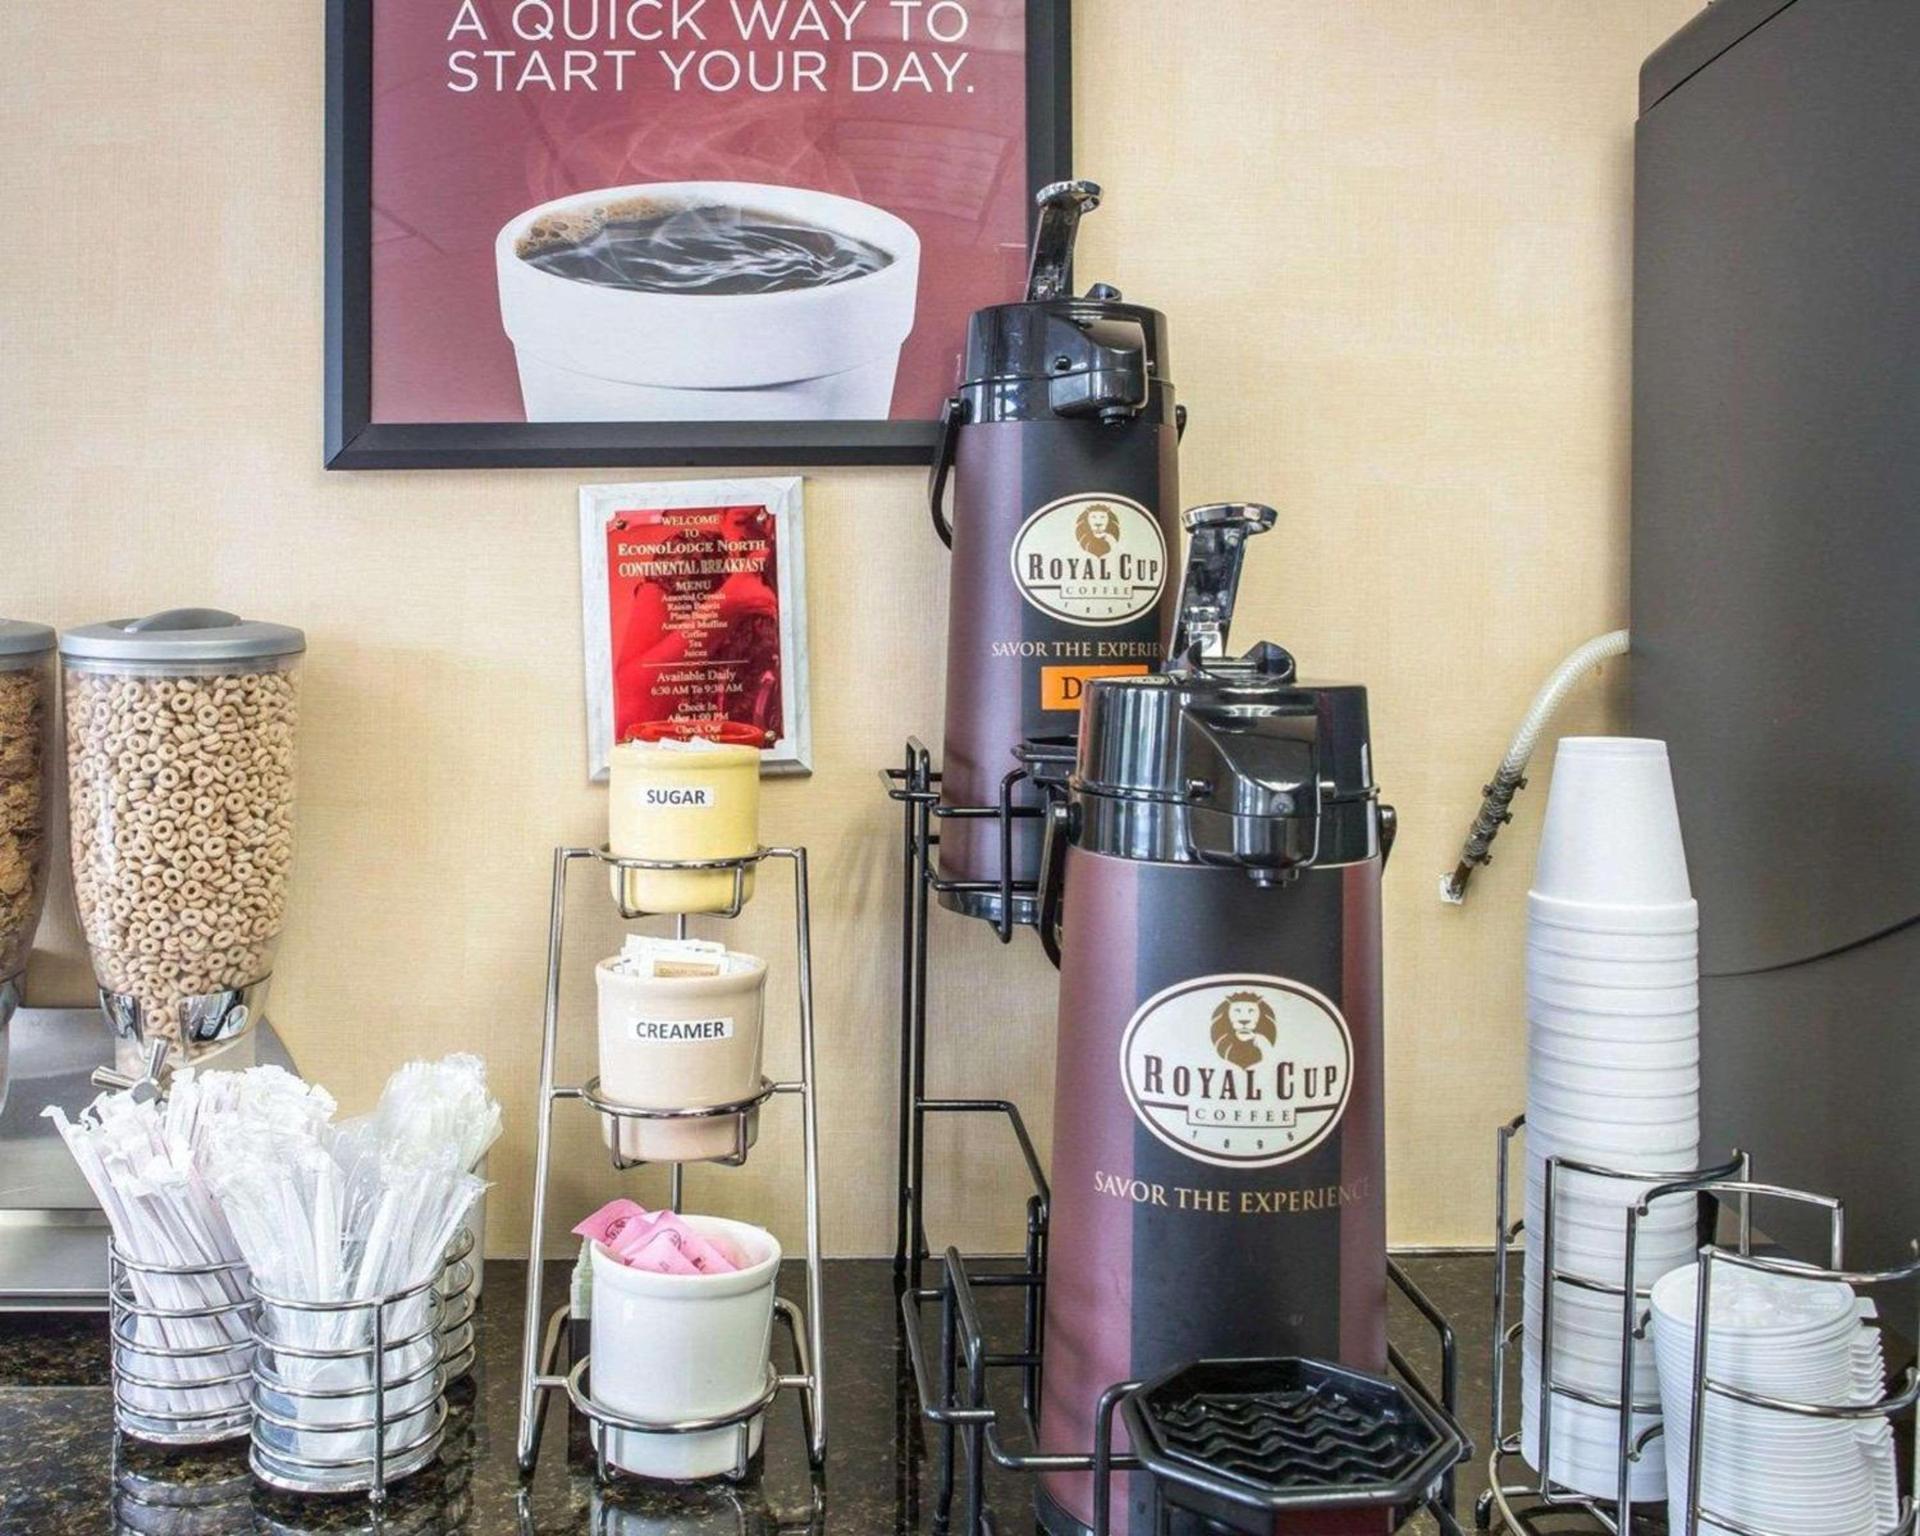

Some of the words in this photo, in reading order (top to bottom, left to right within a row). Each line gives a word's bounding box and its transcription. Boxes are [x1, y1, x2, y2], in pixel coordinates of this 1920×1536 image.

[446, 0, 488, 41] A
[511, 0, 706, 42] QUICK
[731, 0, 868, 41] WAY
[890, 0, 970, 42] TO
[447, 50, 636, 93] START
[659, 50, 828, 93] YOUR
[851, 50, 975, 93] DAY.
[662, 514, 719, 526] WELCOME
[684, 528, 700, 538] TO
[718, 540, 768, 553] NORTH
[619, 560, 700, 577] CONTINENTAL
[701, 557, 766, 575] BREAKFAST
[1028, 553, 1111, 580] ROYAL
[1120, 553, 1158, 581] CUP
[676, 580, 711, 591] MENU
[1066, 586, 1131, 596] COFFEE
[697, 620, 728, 629] Muffins
[681, 630, 708, 638] Coffee
[689, 640, 702, 648] Tea
[992, 641, 1047, 657] SAVOR
[1052, 642, 1092, 657] THE
[684, 649, 708, 657] Juices
[657, 671, 706, 682] Available
[708, 667, 736, 681] Daily
[672, 685, 689, 695] AM
[692, 685, 703, 694] To
[705, 684, 724, 693] 9:30
[725, 683, 743, 693] AM
[678, 703, 706, 713] Check
[667, 713, 691, 723] After
[646, 789, 706, 805] SUGAR
[636, 1021, 725, 1039] CREAMER
[1143, 1054, 1262, 1101] ROYAL
[1277, 1062, 1338, 1100] CUP
[1195, 1109, 1290, 1123] COFFEE
[1094, 1170, 1168, 1207] SAVOR
[1174, 1187, 1230, 1213] THE
[1240, 1175, 1371, 1214] EXPERIENCE
